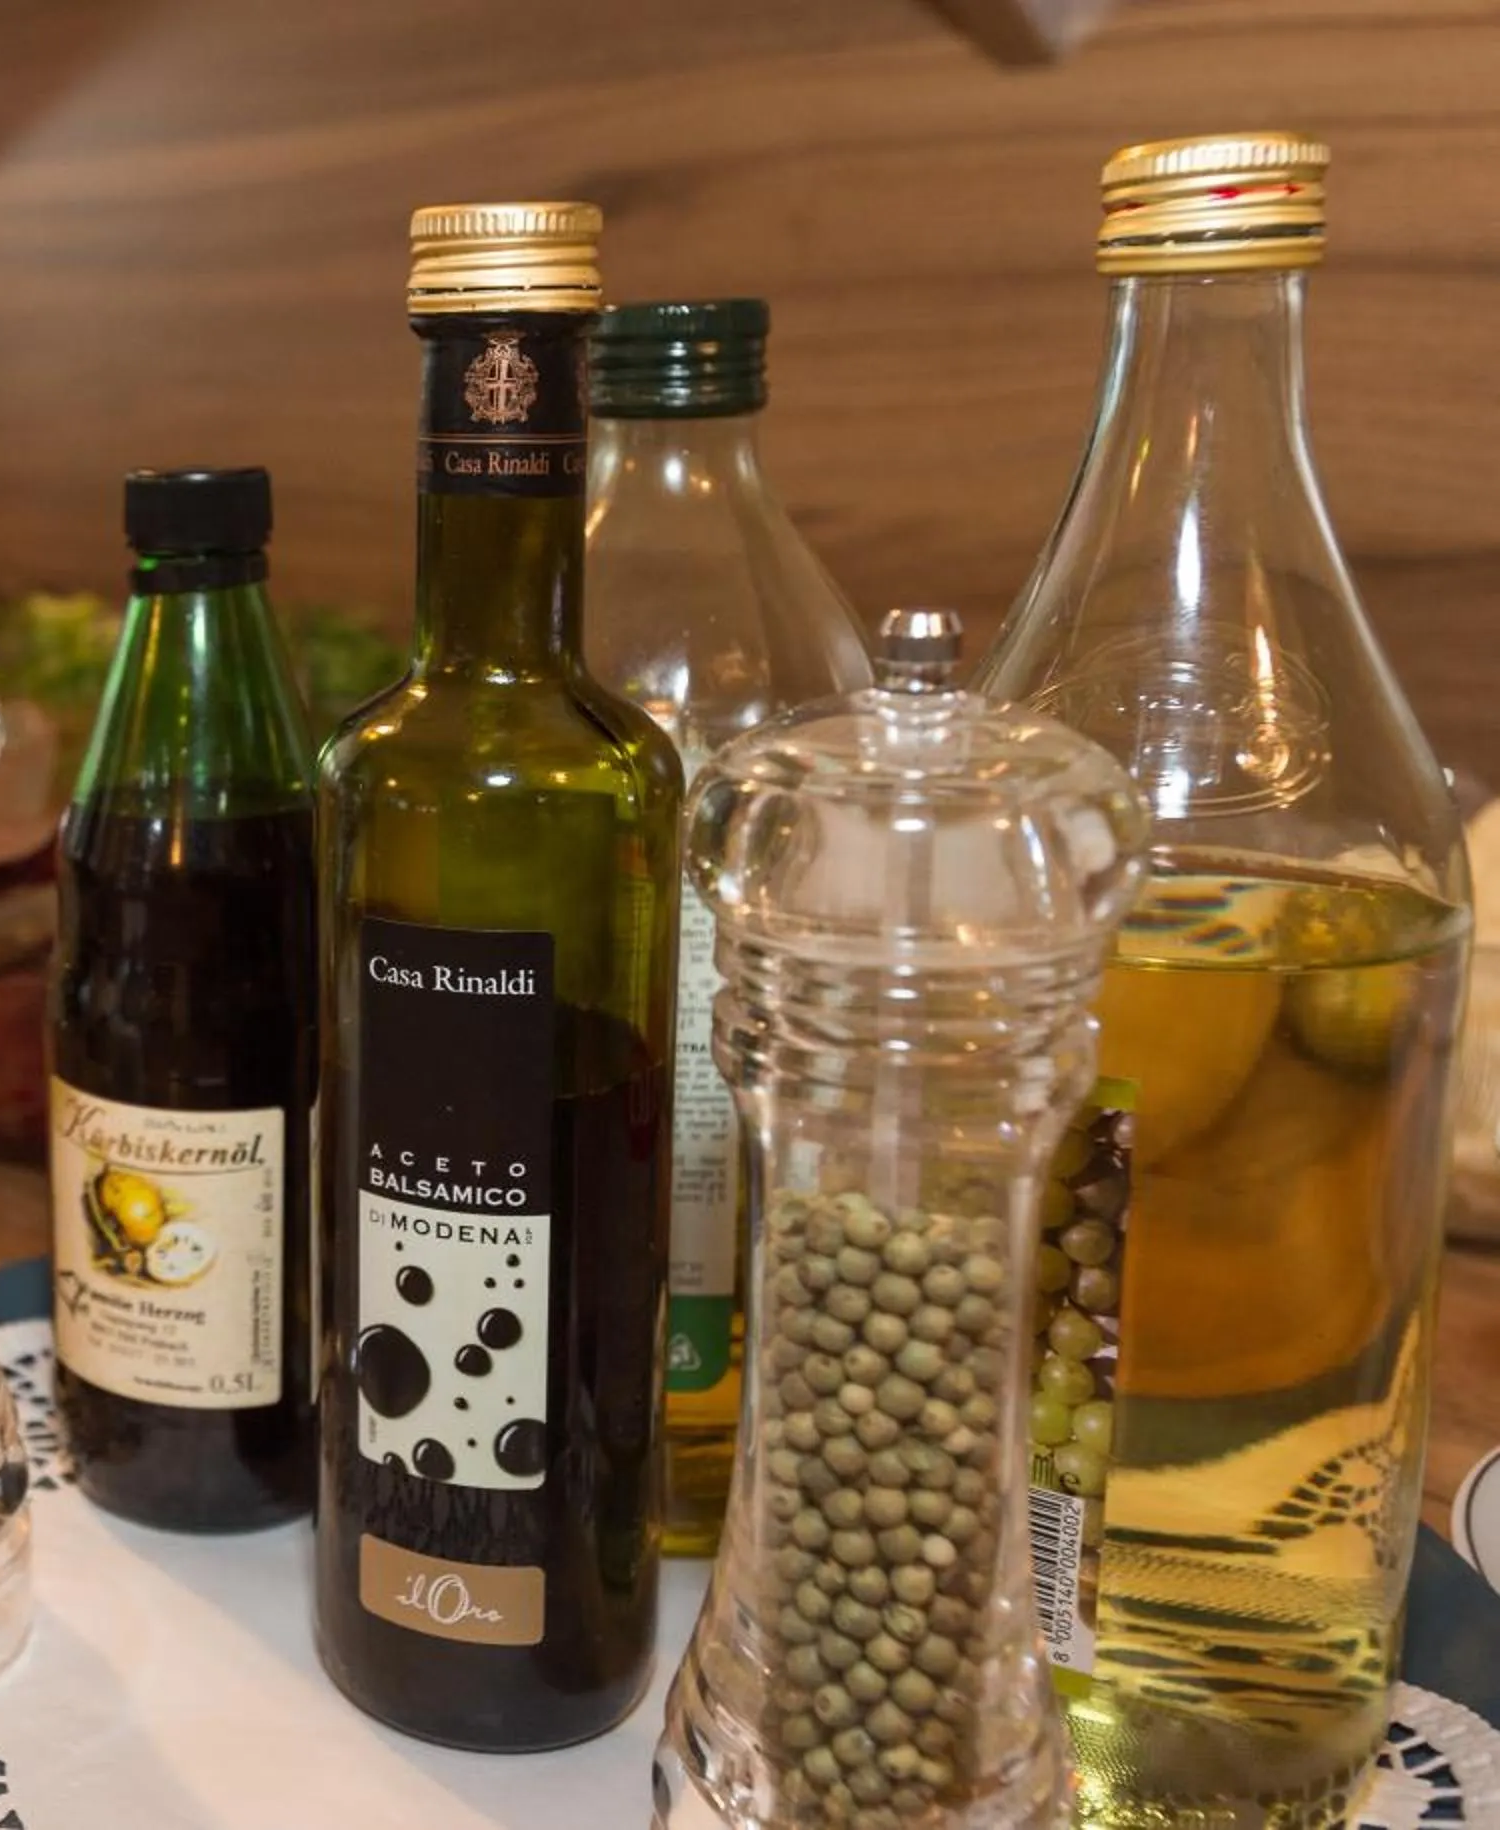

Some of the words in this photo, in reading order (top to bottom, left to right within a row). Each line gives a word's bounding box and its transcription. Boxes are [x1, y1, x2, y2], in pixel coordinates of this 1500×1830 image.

[445, 452, 482, 476] Casa
[488, 451, 550, 475] Rinaldi
[369, 956, 423, 989] Casa
[432, 966, 536, 995] Rinaldi
[369, 1142, 526, 1177] ACETO
[369, 1168, 526, 1206] BALSAMICO
[369, 1209, 386, 1226] DI
[391, 1213, 522, 1245] MODENA
[1059, 1504, 1082, 1571] 004002
[428, 1573, 504, 1625] Oro
[1056, 1576, 1077, 1641] 005140
[1052, 1653, 1071, 1664] 8
